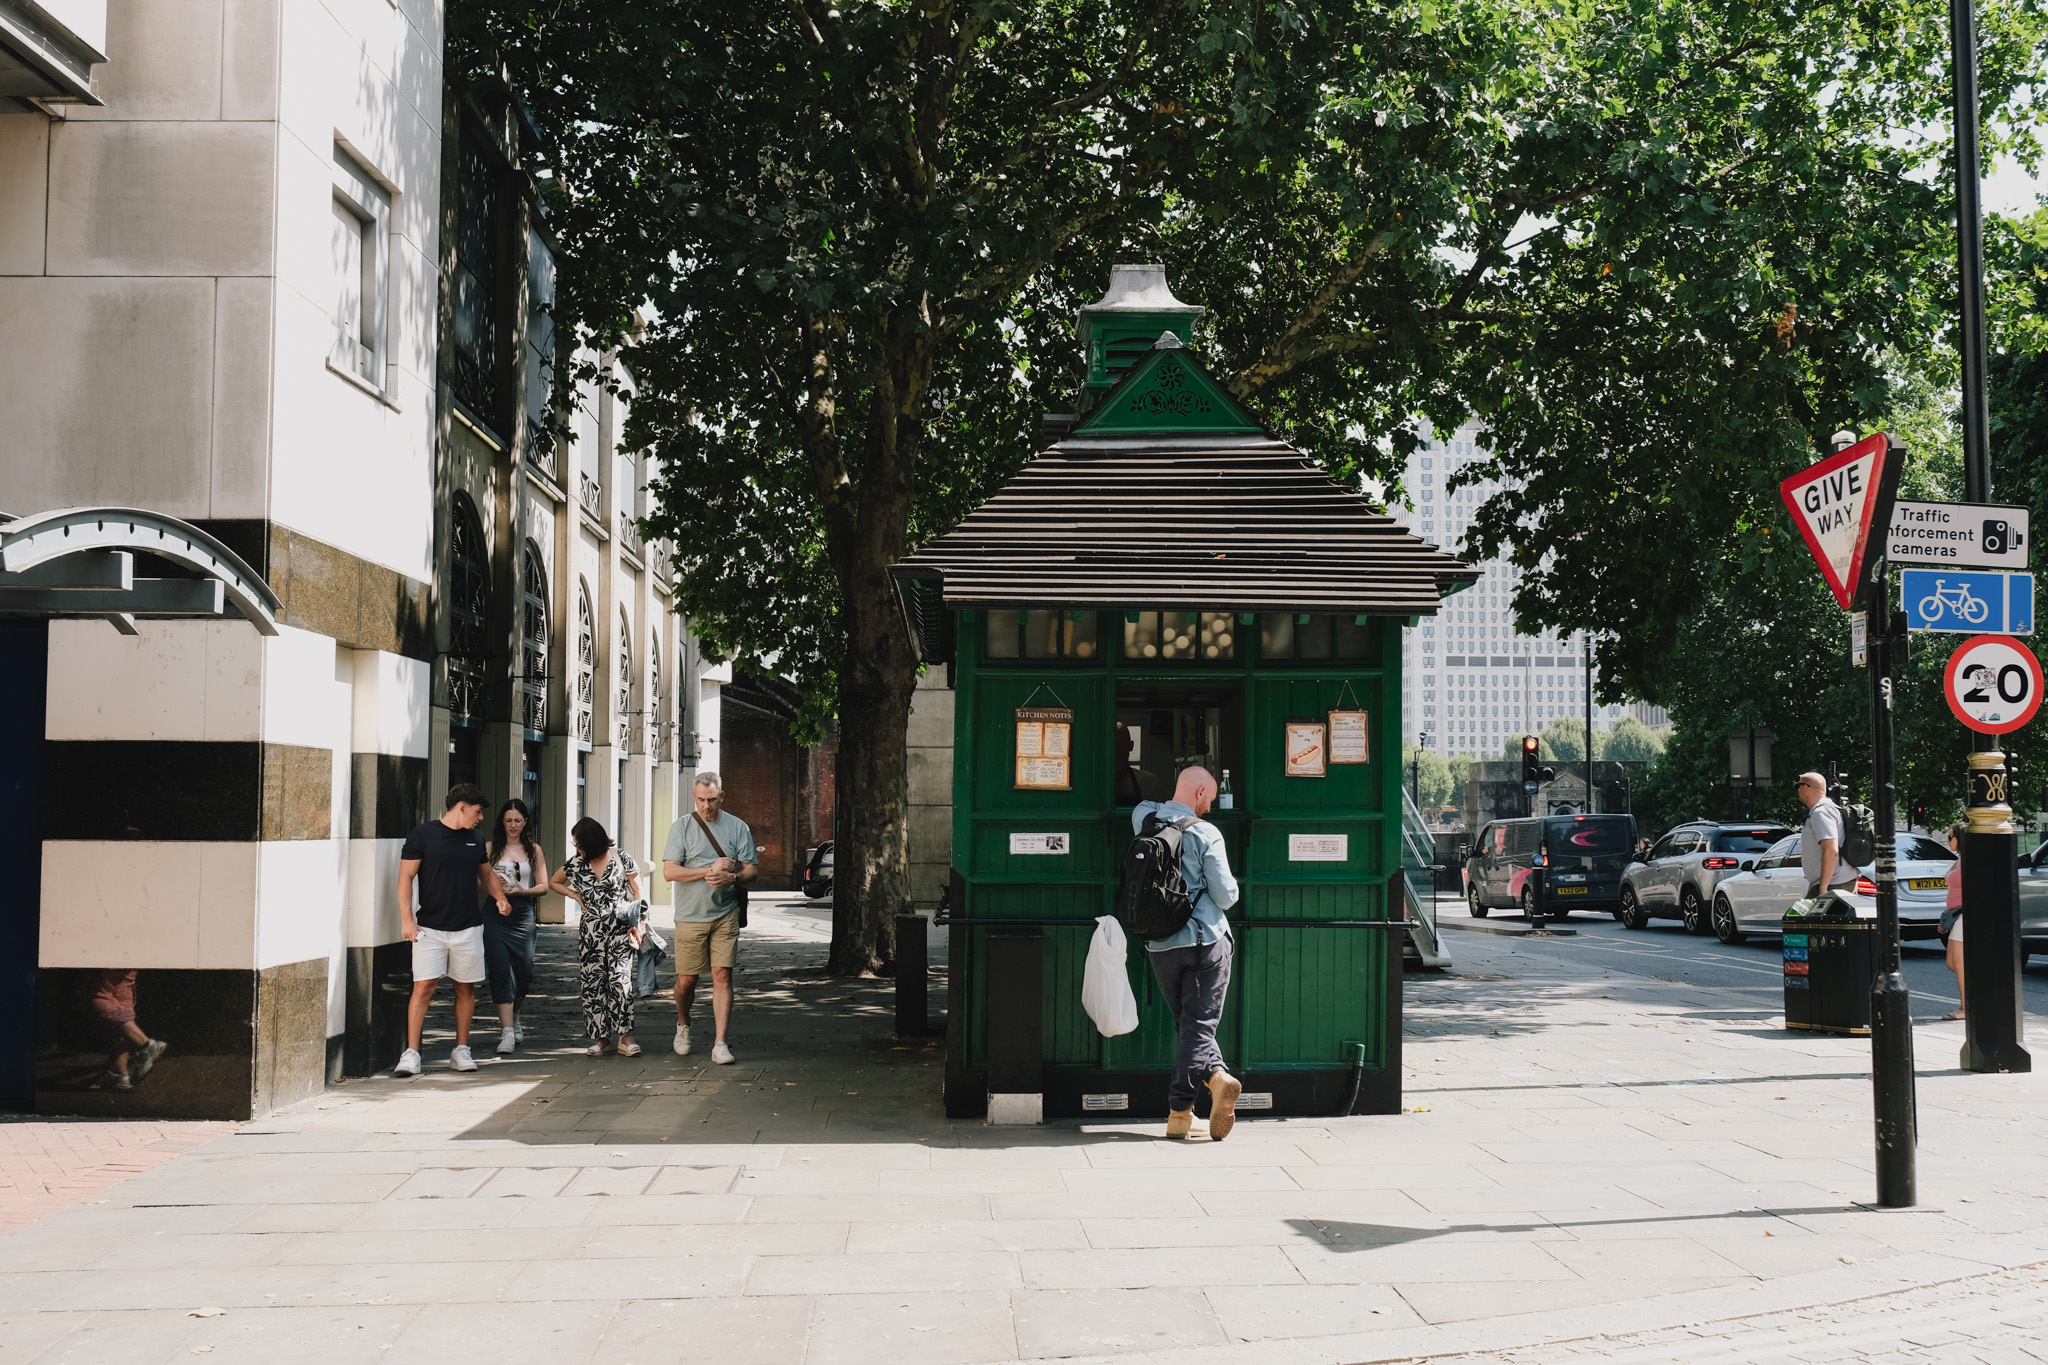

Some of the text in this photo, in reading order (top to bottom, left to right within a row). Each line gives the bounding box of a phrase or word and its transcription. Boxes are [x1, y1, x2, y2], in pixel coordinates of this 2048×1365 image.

[1804, 463, 1862, 514] GIVE
[1817, 502, 1853, 535] WAY
[1900, 507, 1950, 523] Traffic
[1889, 524, 1974, 541] nforcement
[1892, 544, 1957, 557] cameras
[1962, 663, 2029, 704] 20
[1017, 711, 1049, 719] KITCHEN
[1915, 880, 1932, 889] W121
